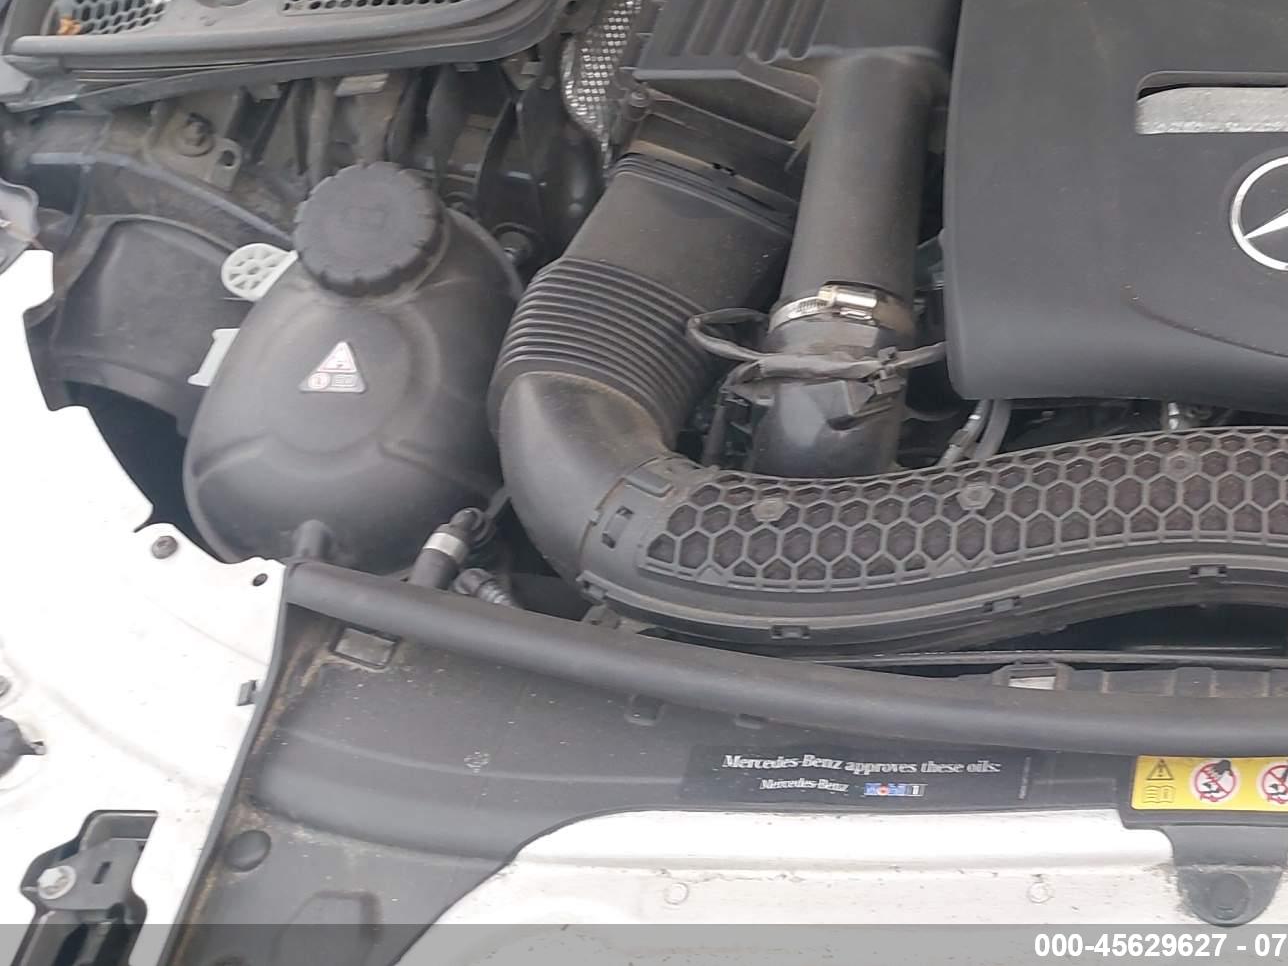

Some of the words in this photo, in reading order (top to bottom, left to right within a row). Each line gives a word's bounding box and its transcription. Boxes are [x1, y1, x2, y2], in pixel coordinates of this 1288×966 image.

[722, 754, 843, 770] Mercedes-Benz
[844, 761, 917, 775] approves
[921, 760, 964, 773] these
[967, 759, 1002, 773] oils:
[760, 778, 849, 792] Mercedes-Benz
